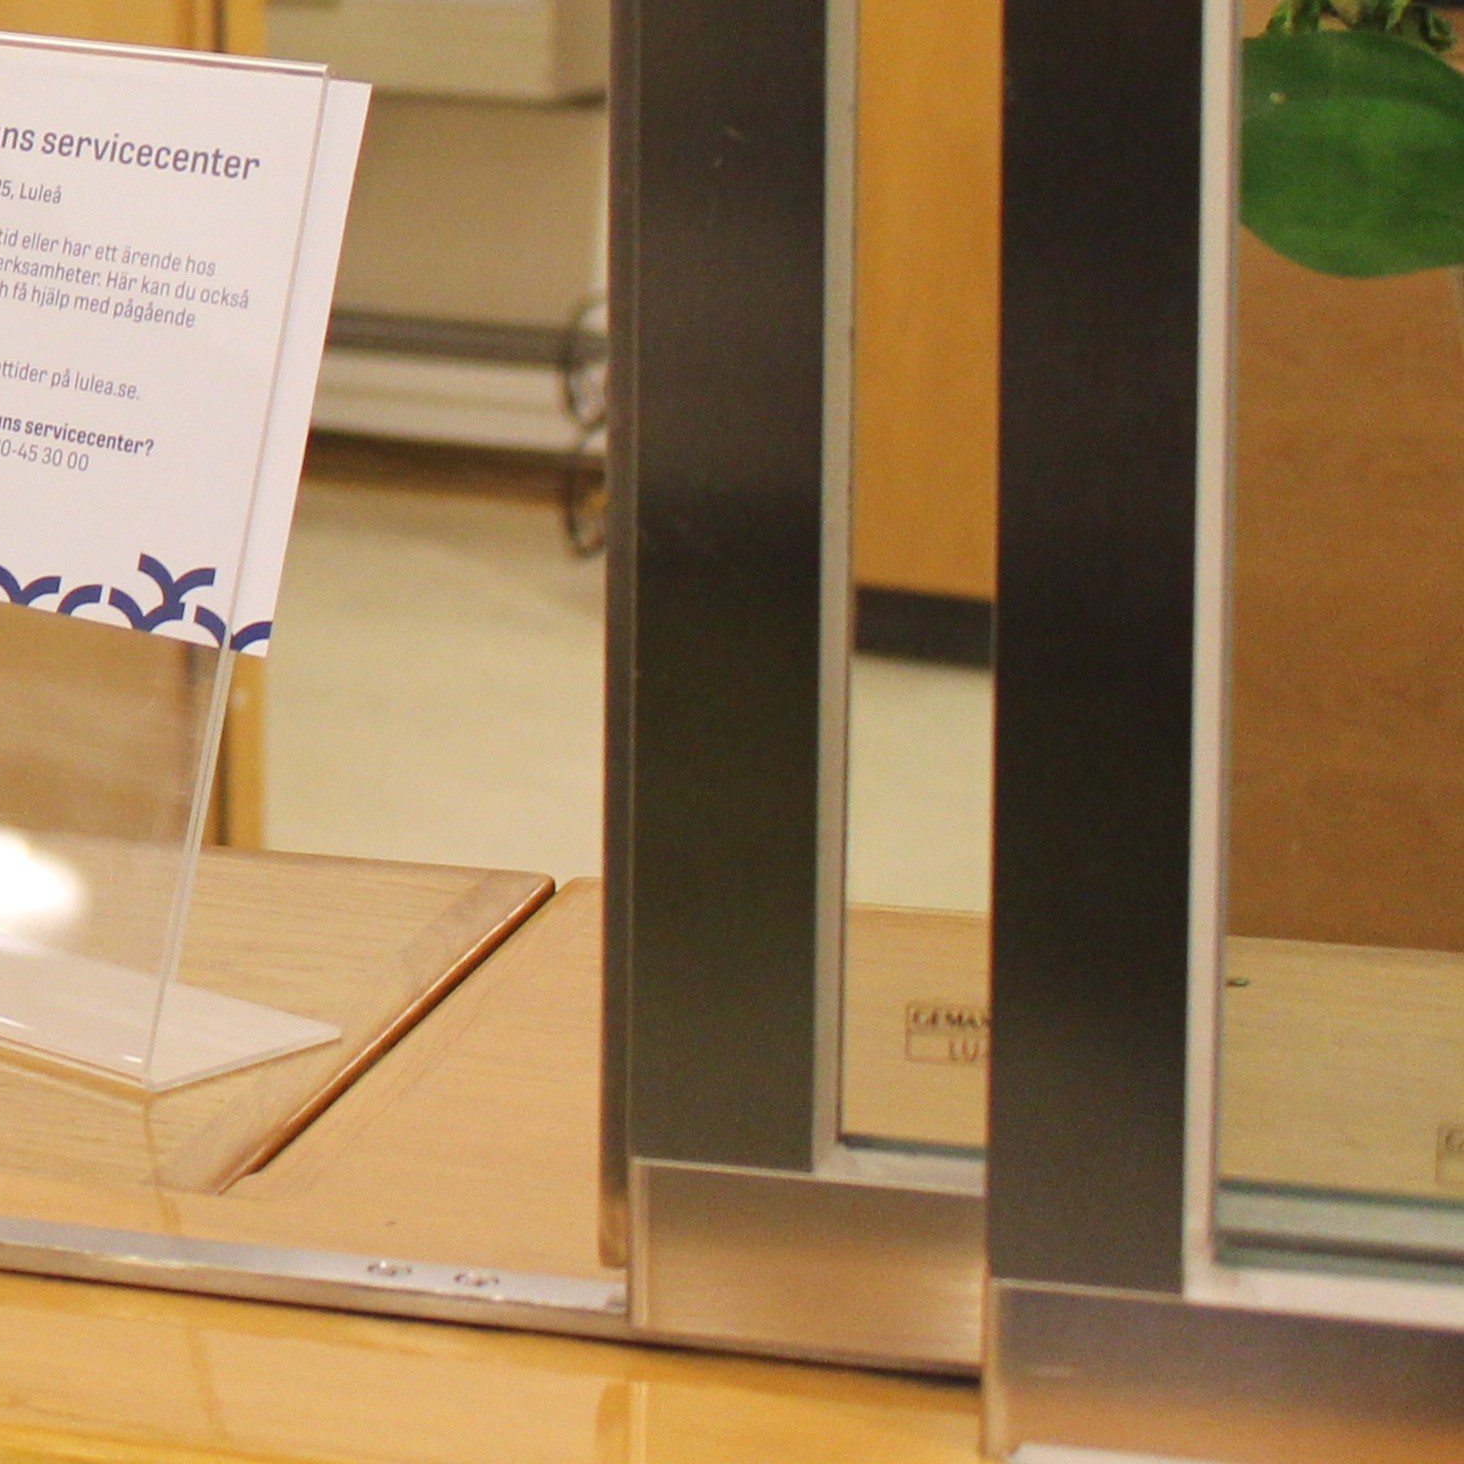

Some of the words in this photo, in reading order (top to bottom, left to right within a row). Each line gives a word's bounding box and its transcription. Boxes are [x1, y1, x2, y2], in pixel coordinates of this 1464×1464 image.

[41, 132, 260, 179] servicecenter
[19, 182, 62, 204] Luleå
[21, 233, 59, 252] eller
[62, 237, 92, 257] har
[95, 245, 118, 262] ett
[121, 247, 181, 272] ärende
[185, 255, 216, 276] hos
[12, 282, 27, 301] få
[31, 285, 70, 310] hjälp
[73, 296, 111, 314] med
[113, 299, 195, 328] pågående
[106, 270, 138, 291] Här
[141, 275, 170, 296] kan
[174, 281, 196, 301] du
[200, 287, 249, 309] också
[50, 369, 70, 388] på
[74, 372, 139, 400] lulea.se.
[24, 421, 154, 456] servicecenter?
[41, 447, 63, 467] 30
[66, 451, 89, 471] 00
